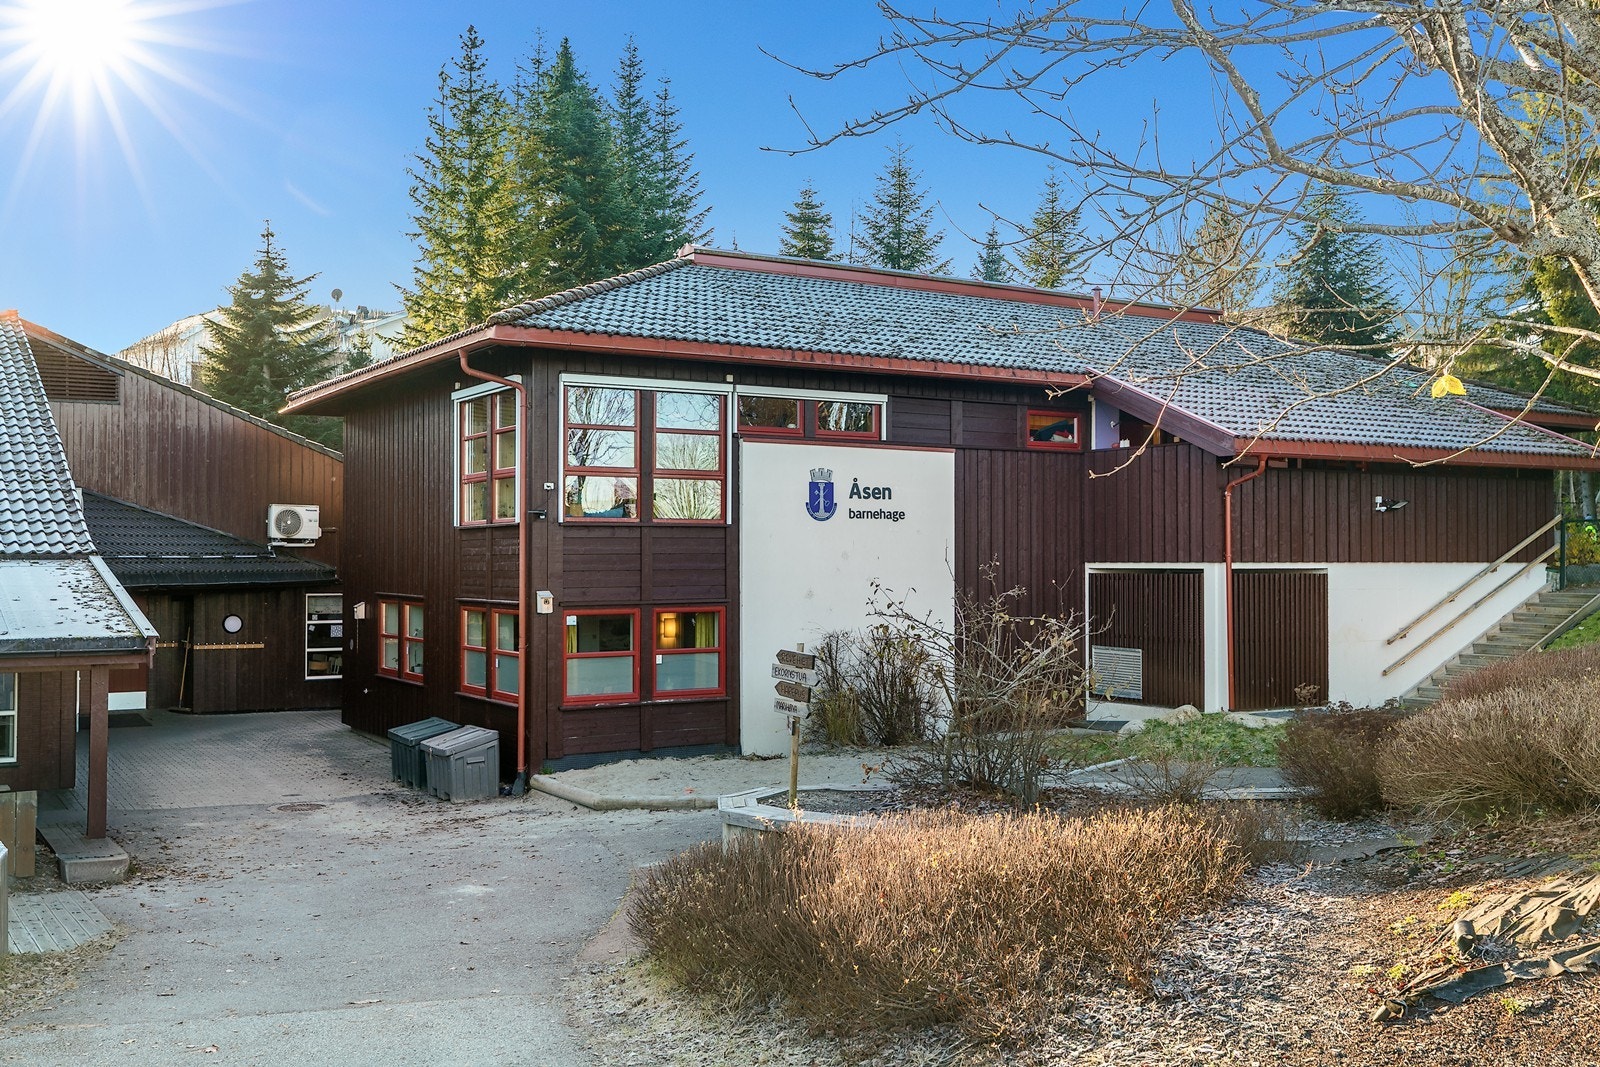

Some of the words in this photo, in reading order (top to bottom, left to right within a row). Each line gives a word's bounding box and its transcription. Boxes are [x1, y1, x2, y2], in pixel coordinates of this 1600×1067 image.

[849, 478, 892, 500] Åsen
[848, 508, 906, 522] barnehage
[774, 667, 807, 682] EKORNSTUA
